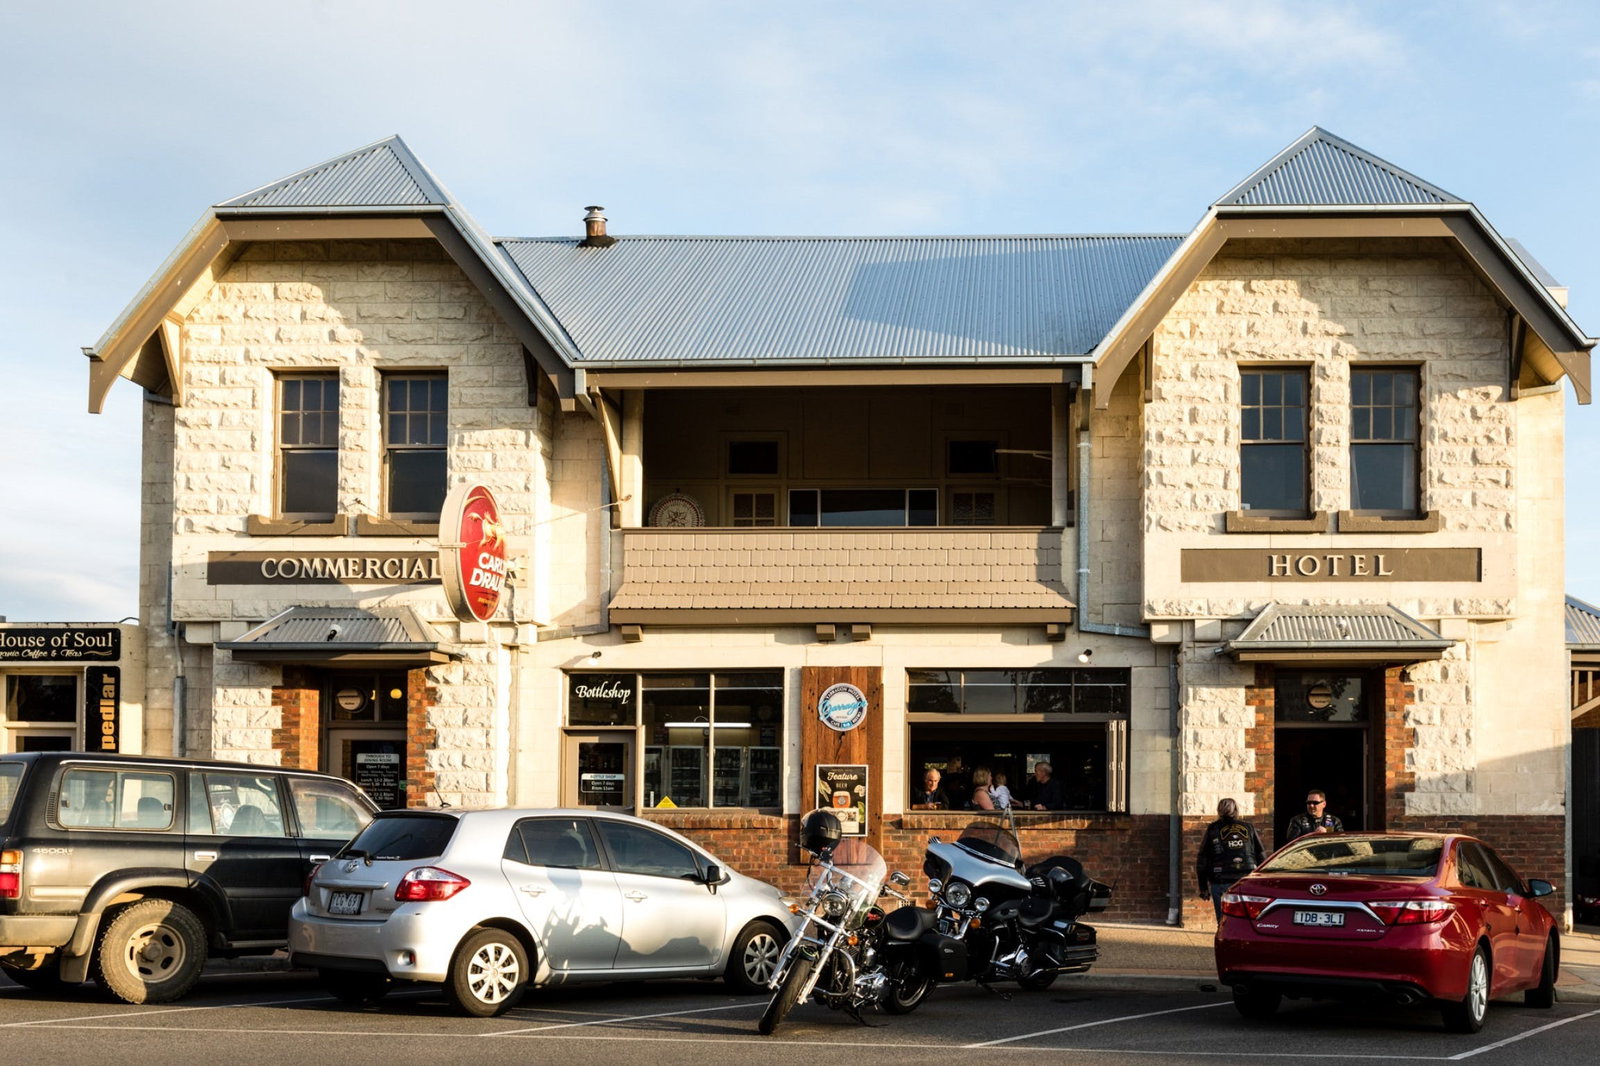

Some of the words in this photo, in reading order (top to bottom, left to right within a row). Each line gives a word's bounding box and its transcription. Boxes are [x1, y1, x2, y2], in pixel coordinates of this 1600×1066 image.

[260, 556, 443, 579] COMMERCIAL
[1269, 553, 1394, 577] HOTEL
[50, 632, 71, 647] of
[74, 631, 113, 647] Soul
[21, 648, 48, 659] Coffee
[575, 681, 631, 705] Bottleshop
[100, 674, 116, 750] pedlar
[827, 771, 859, 781] Feature
[1228, 839, 1244, 848] HOG
